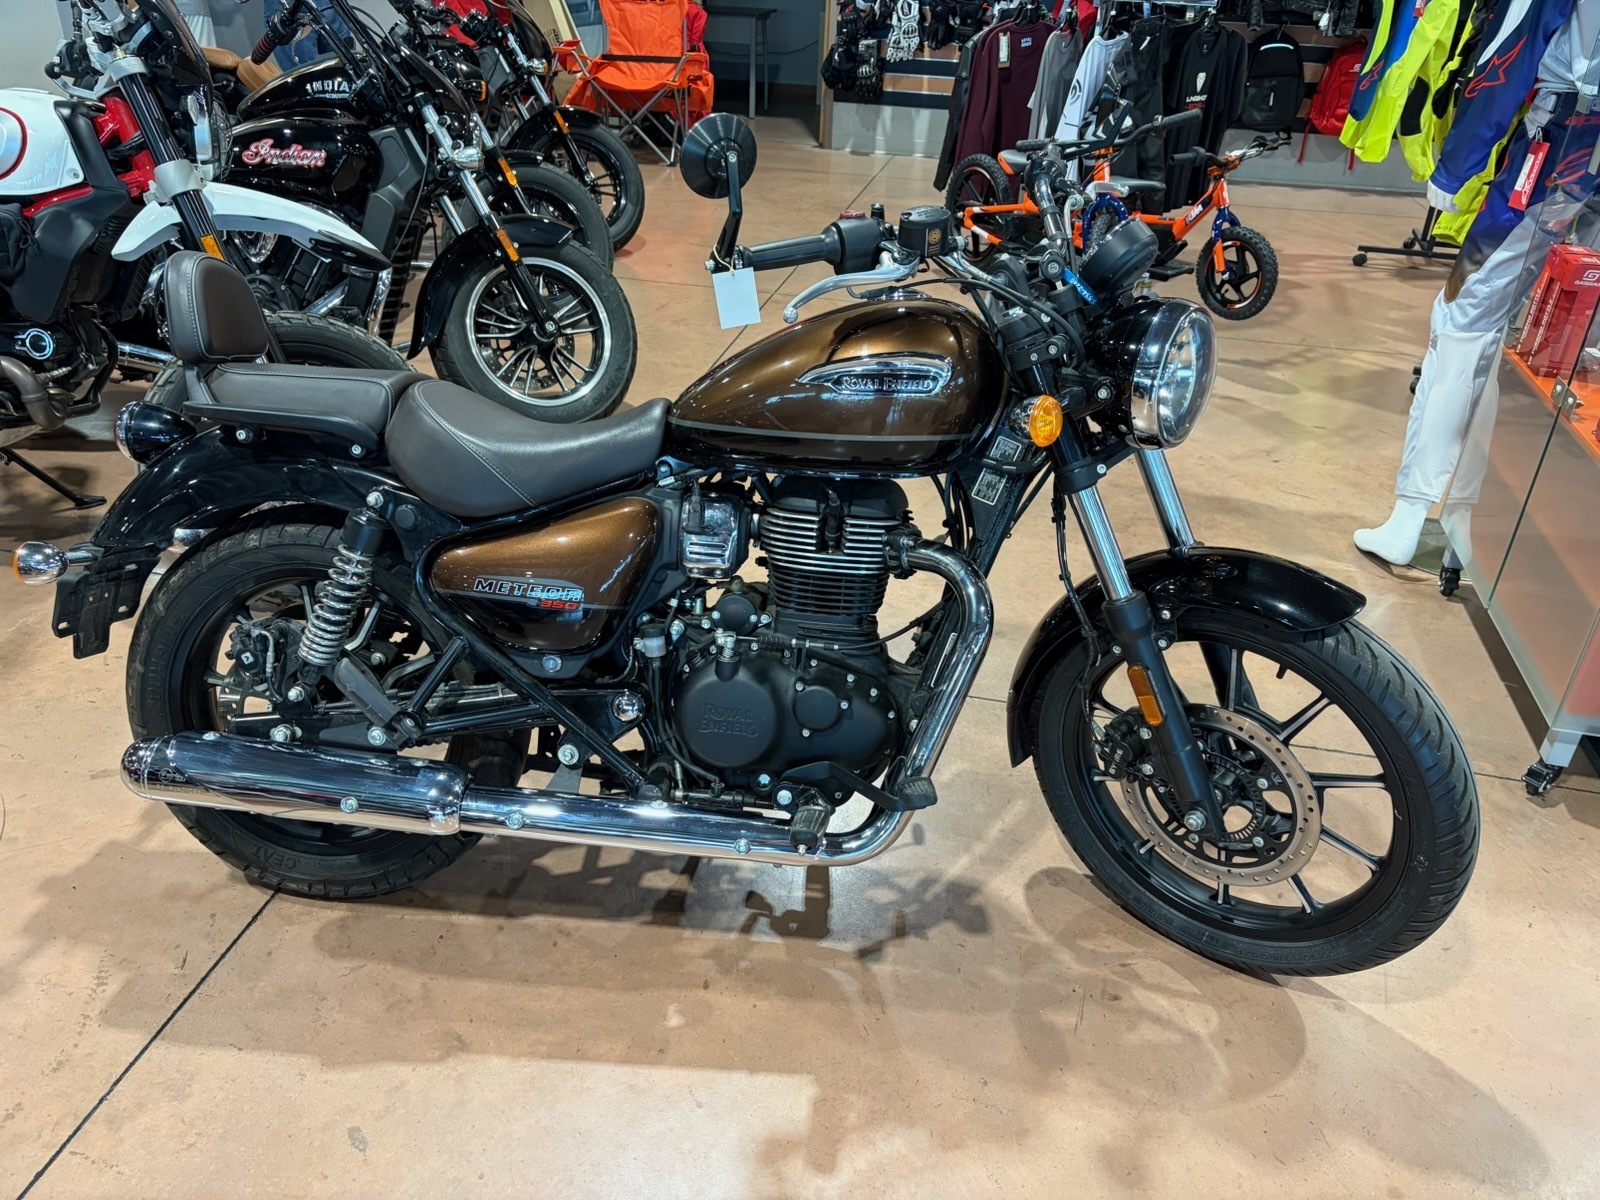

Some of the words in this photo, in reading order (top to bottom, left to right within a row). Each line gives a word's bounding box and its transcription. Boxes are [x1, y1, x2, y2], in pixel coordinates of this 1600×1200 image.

[241, 138, 327, 168] Indian
[841, 376, 882, 390] ROYAL
[883, 376, 933, 391] ENFIELD
[474, 579, 583, 602] METEOR
[540, 600, 579, 611] 350
[703, 703, 752, 721] ROYAL
[698, 720, 758, 738] ENFIELD
